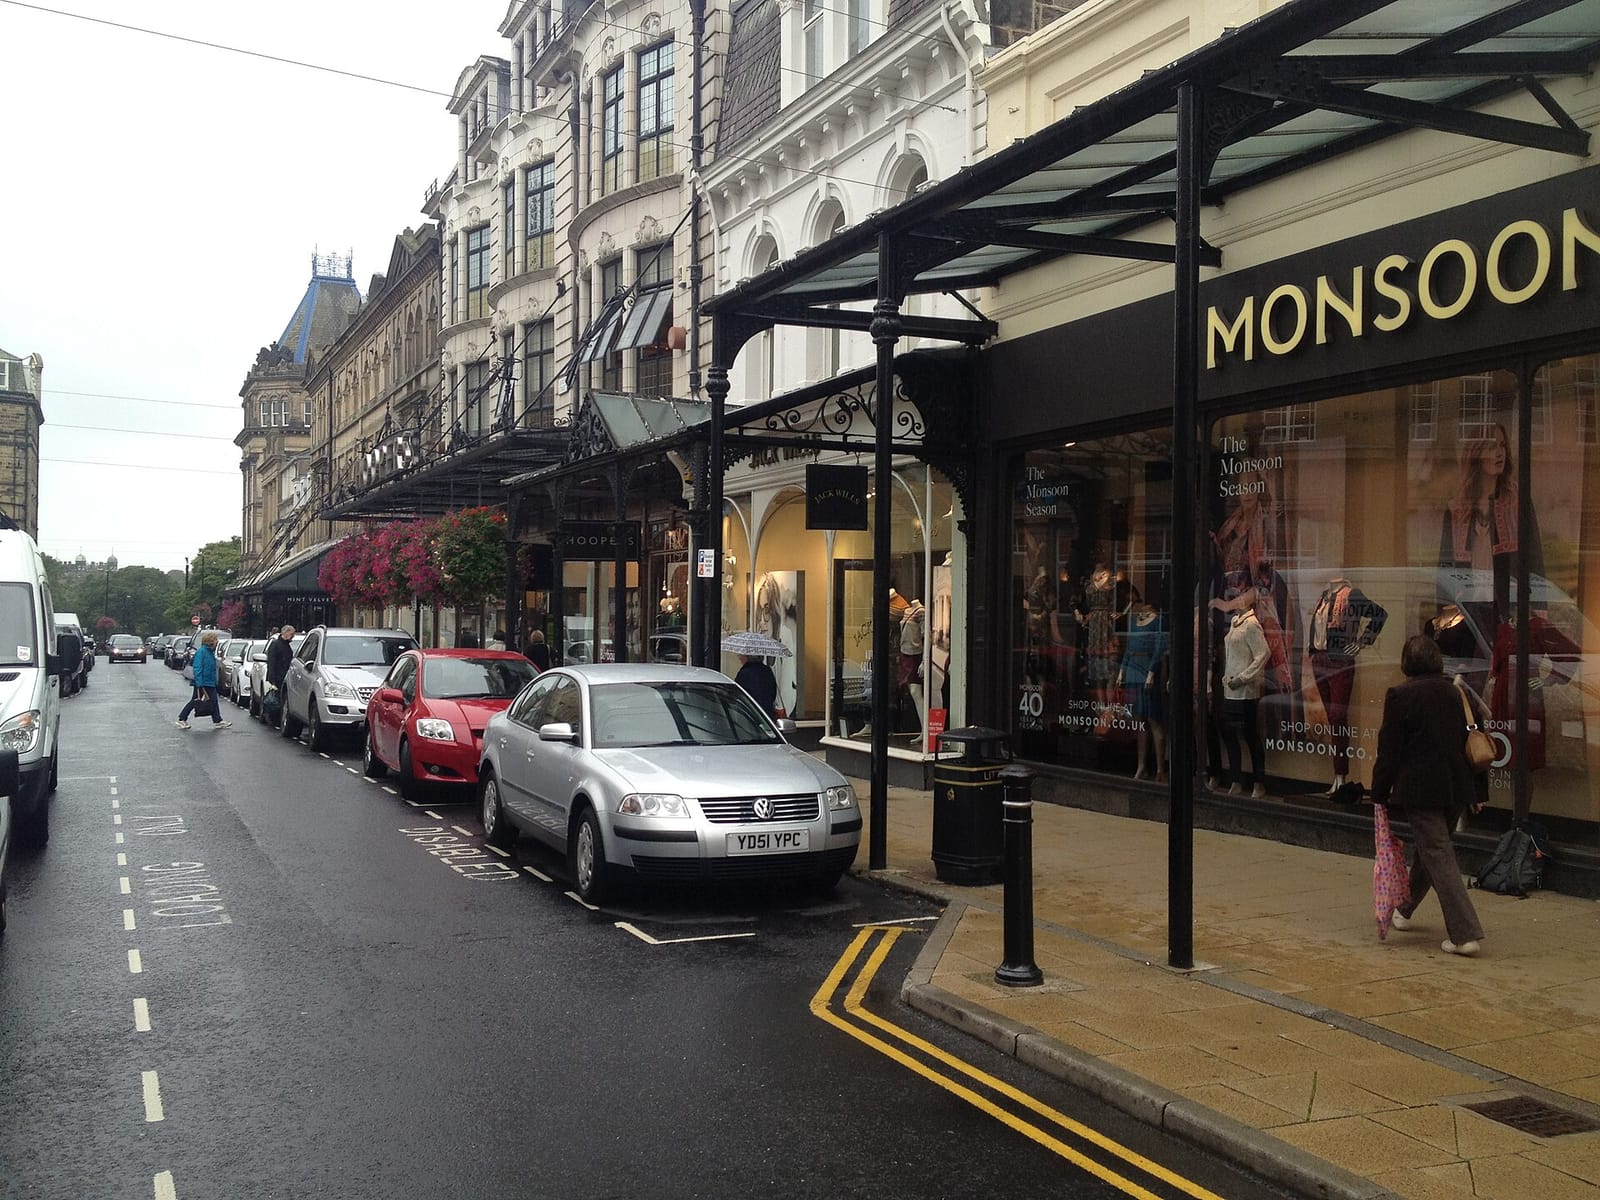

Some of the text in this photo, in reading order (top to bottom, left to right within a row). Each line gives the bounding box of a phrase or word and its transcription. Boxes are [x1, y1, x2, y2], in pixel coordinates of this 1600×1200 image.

[1206, 208, 1600, 369] MONSOON
[1220, 435, 1246, 454] The
[1026, 466, 1045, 480] The
[1220, 455, 1282, 476] Monsoon
[814, 489, 834, 505] JACK
[1026, 484, 1069, 499] Monsoon
[1220, 480, 1265, 498] Season
[1026, 502, 1057, 517] Season
[566, 536, 634, 546] HOOPES
[1019, 692, 1043, 717] 40
[1068, 700, 1133, 713] SHOP ONLINE AT
[1058, 715, 1146, 732] MONSOON.CO.UK
[1280, 720, 1378, 739] SHOP ONLINE AT
[1266, 738, 1378, 760] MONSOON.CO.
[738, 832, 801, 850] YD51 YPC
[398, 826, 520, 881] DISABLED
